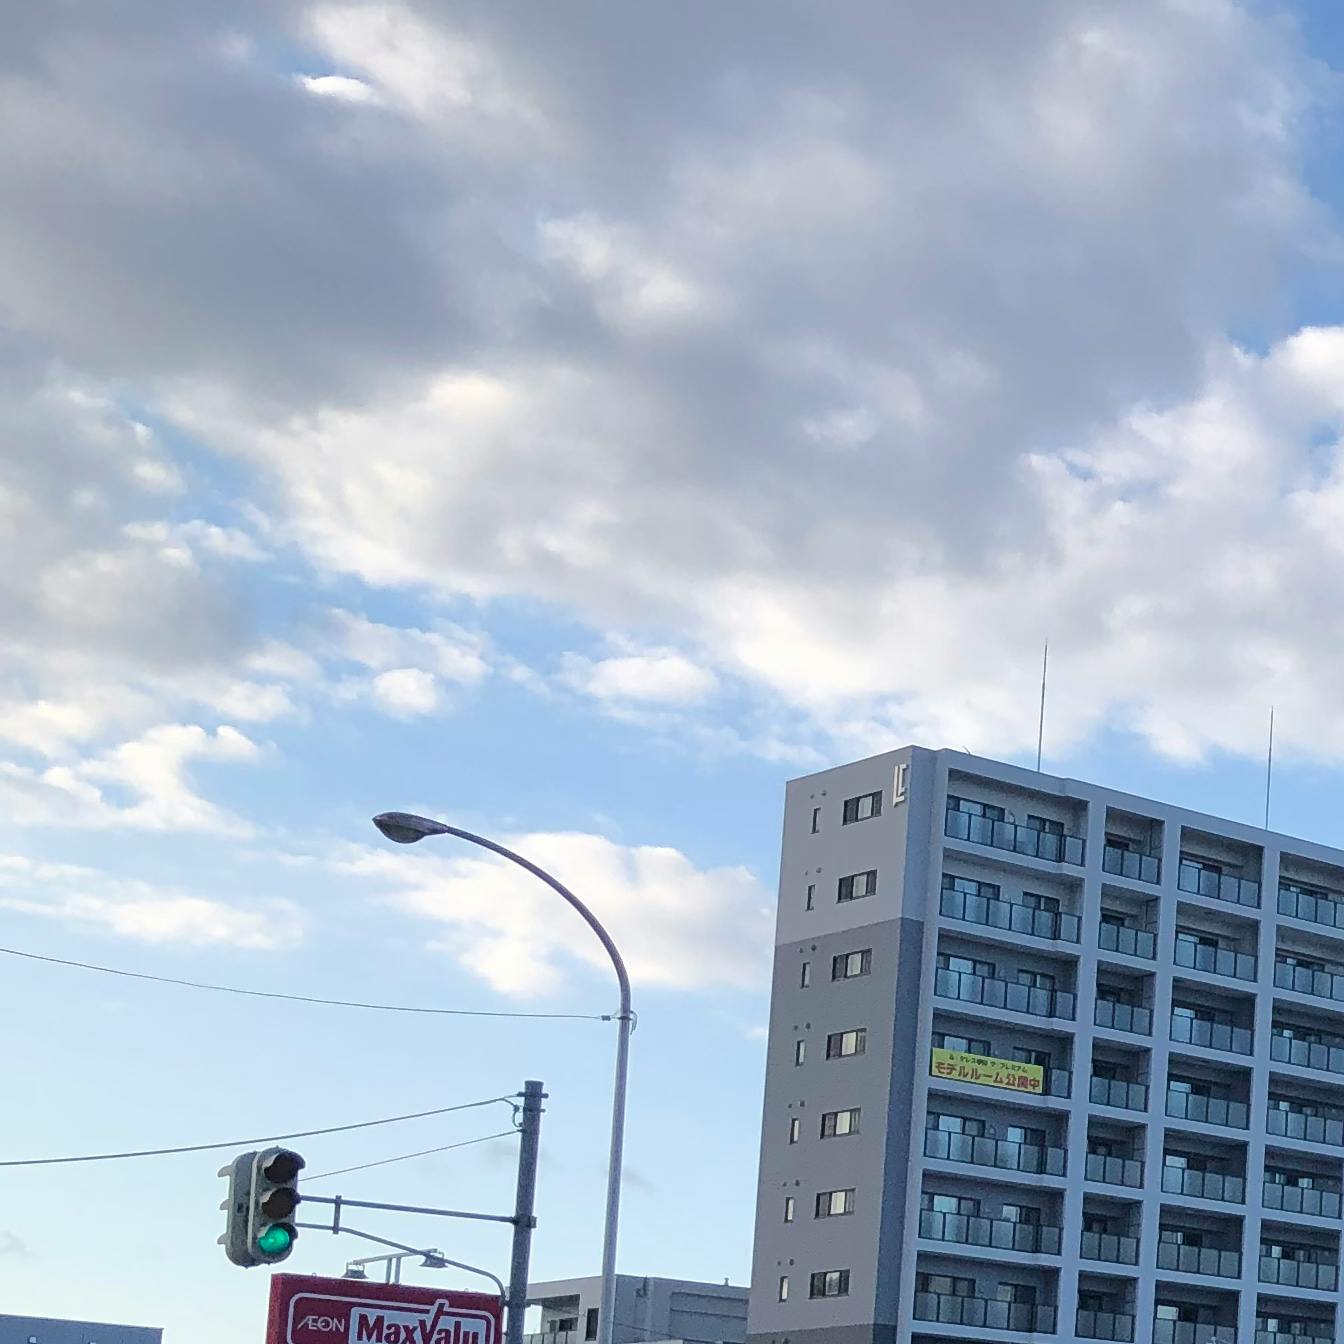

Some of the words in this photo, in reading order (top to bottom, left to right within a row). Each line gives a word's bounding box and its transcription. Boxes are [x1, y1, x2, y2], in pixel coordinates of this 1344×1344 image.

[935, 1061, 1040, 1090] モデルルーム公開中
